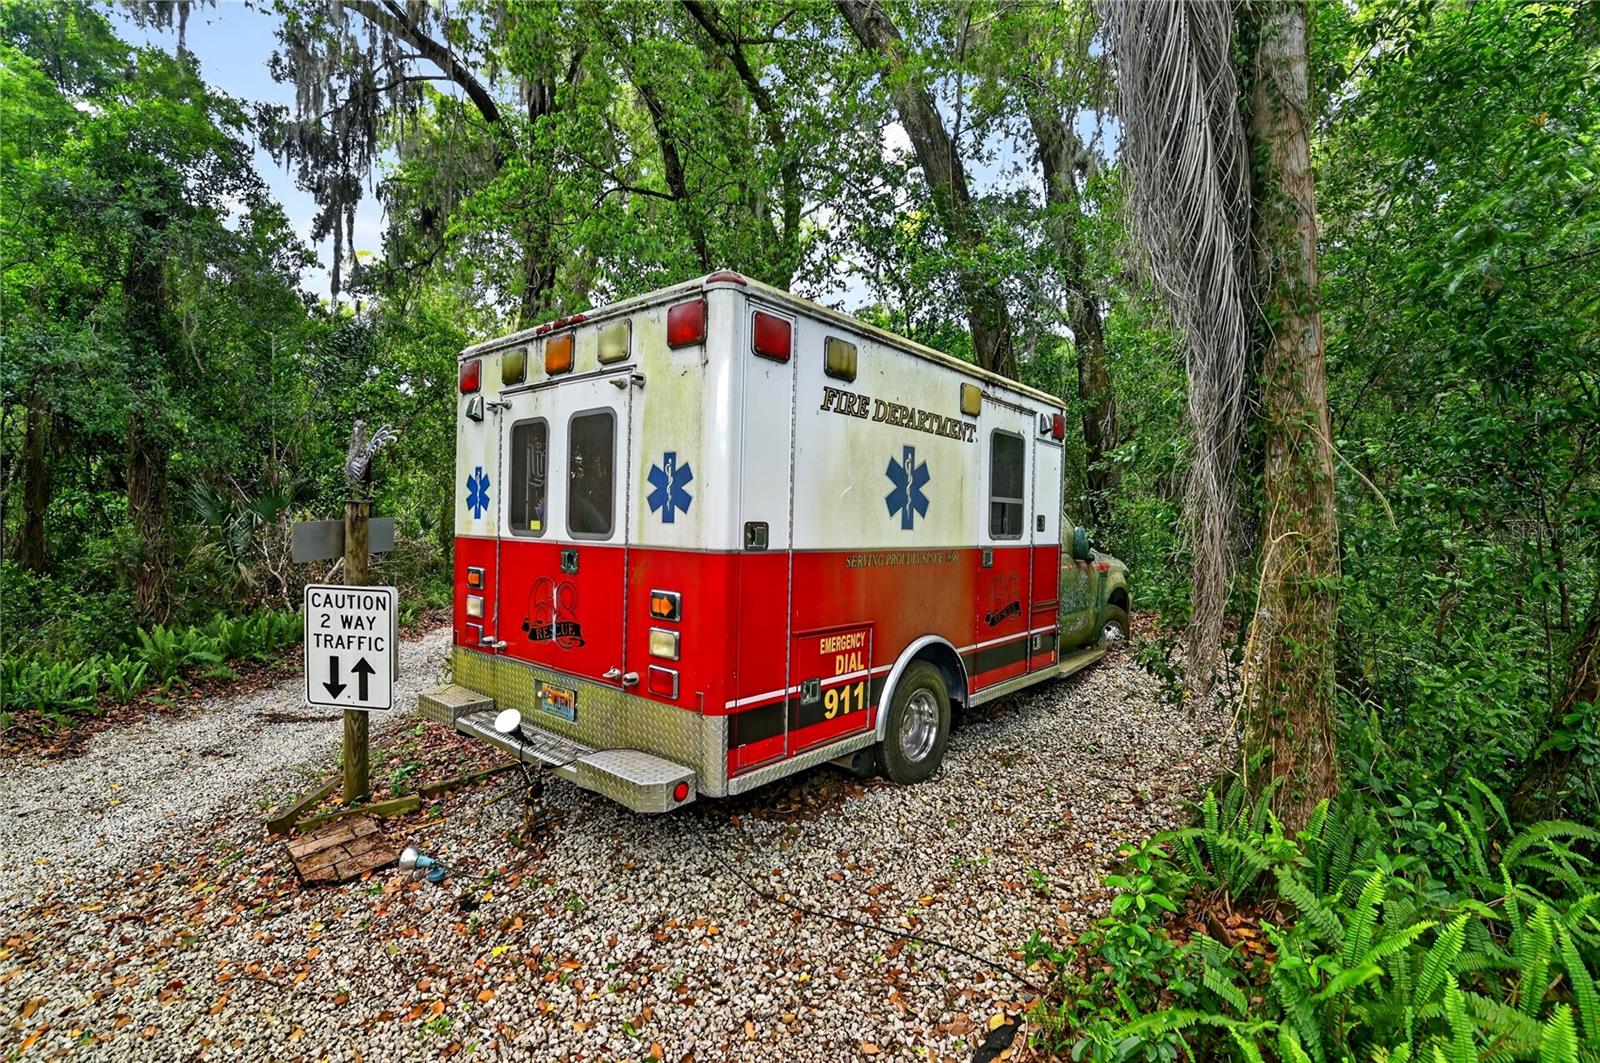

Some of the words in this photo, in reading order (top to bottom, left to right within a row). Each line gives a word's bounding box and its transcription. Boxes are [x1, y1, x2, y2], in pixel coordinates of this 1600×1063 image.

[820, 386, 870, 419] FIRE
[872, 399, 977, 443] DEPARTMENT
[845, 553, 884, 569] SERVING
[311, 592, 387, 612] CAUTION
[320, 613, 331, 628] 2
[341, 614, 376, 631] WAY
[536, 623, 575, 640] RESCUE
[313, 633, 384, 652] TRAFFIC
[820, 632, 866, 655] EMERGENCY
[835, 651, 865, 675] DIAL
[824, 681, 865, 720] 911
